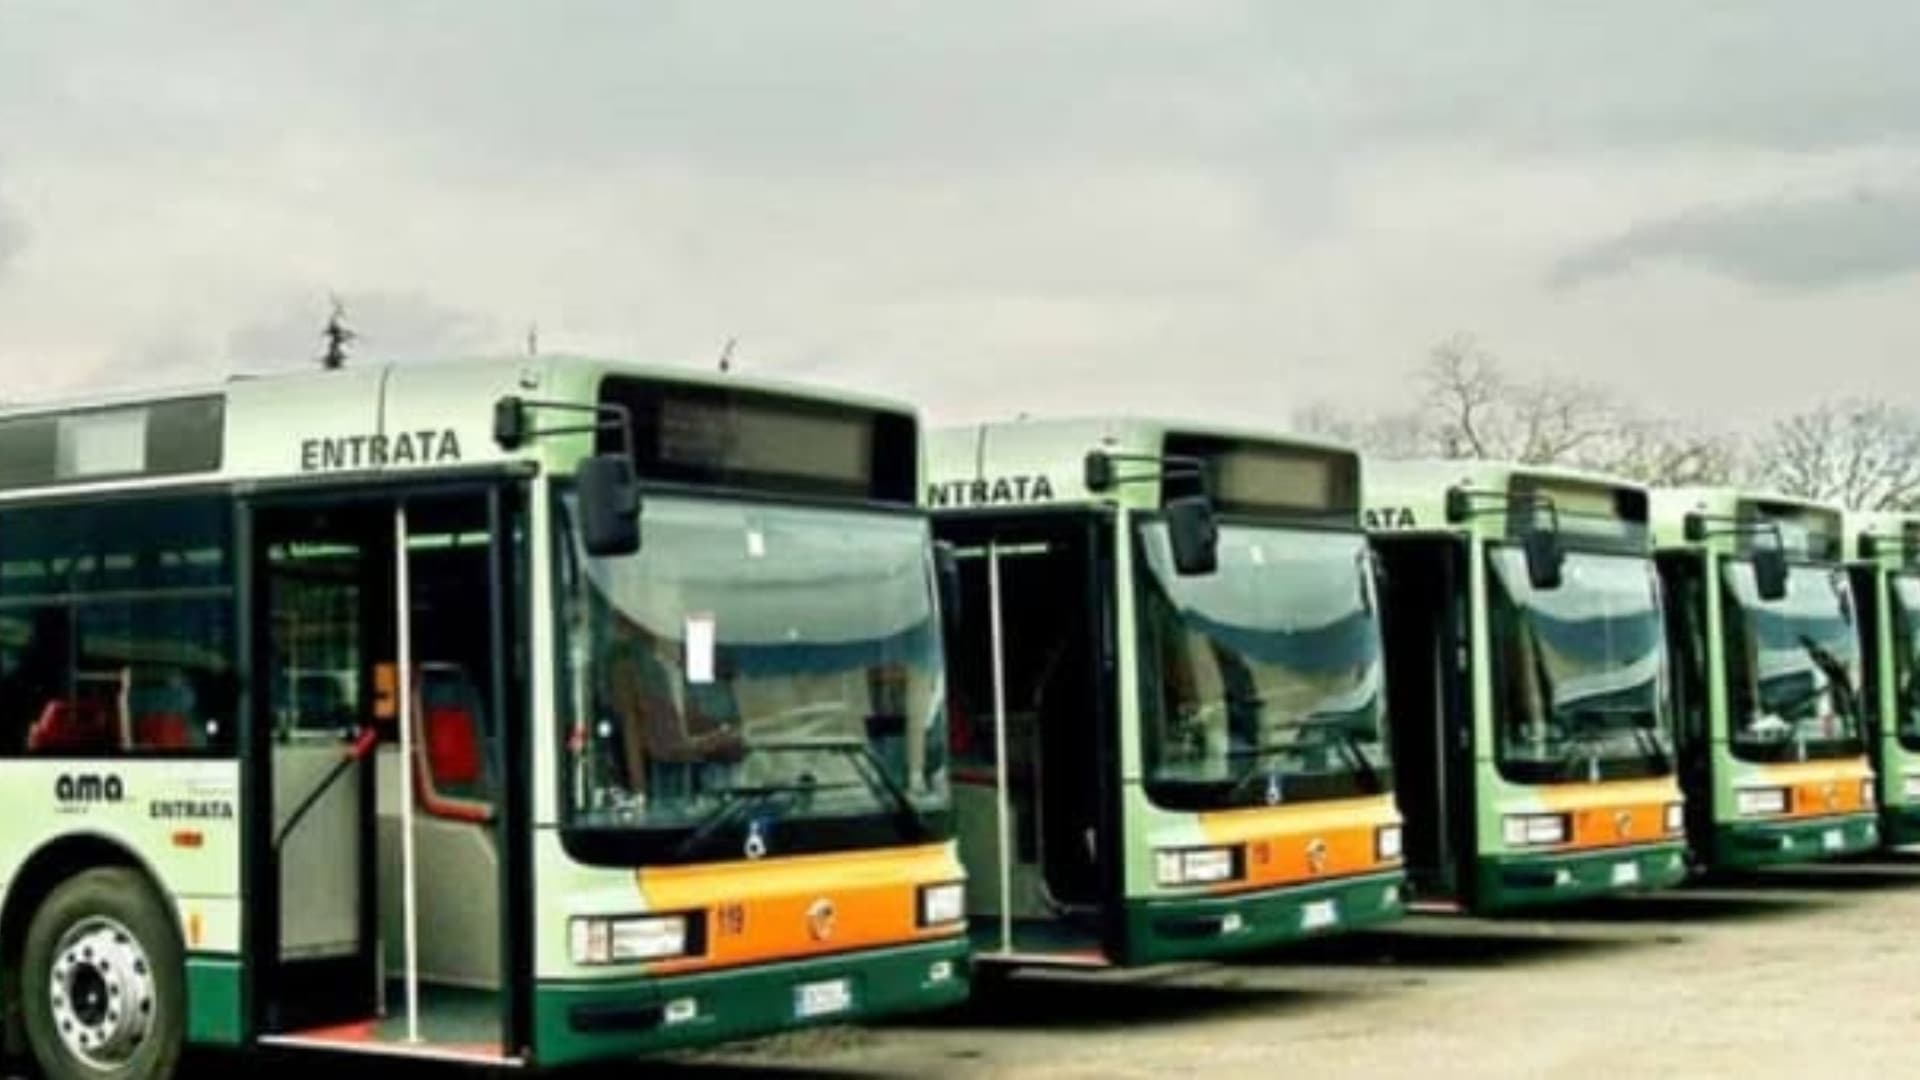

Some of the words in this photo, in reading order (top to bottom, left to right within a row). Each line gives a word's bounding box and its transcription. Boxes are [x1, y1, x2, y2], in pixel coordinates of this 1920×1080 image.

[301, 429, 461, 471] ENTRATA
[55, 774, 123, 801] ama
[150, 801, 233, 818] ENTRATA
